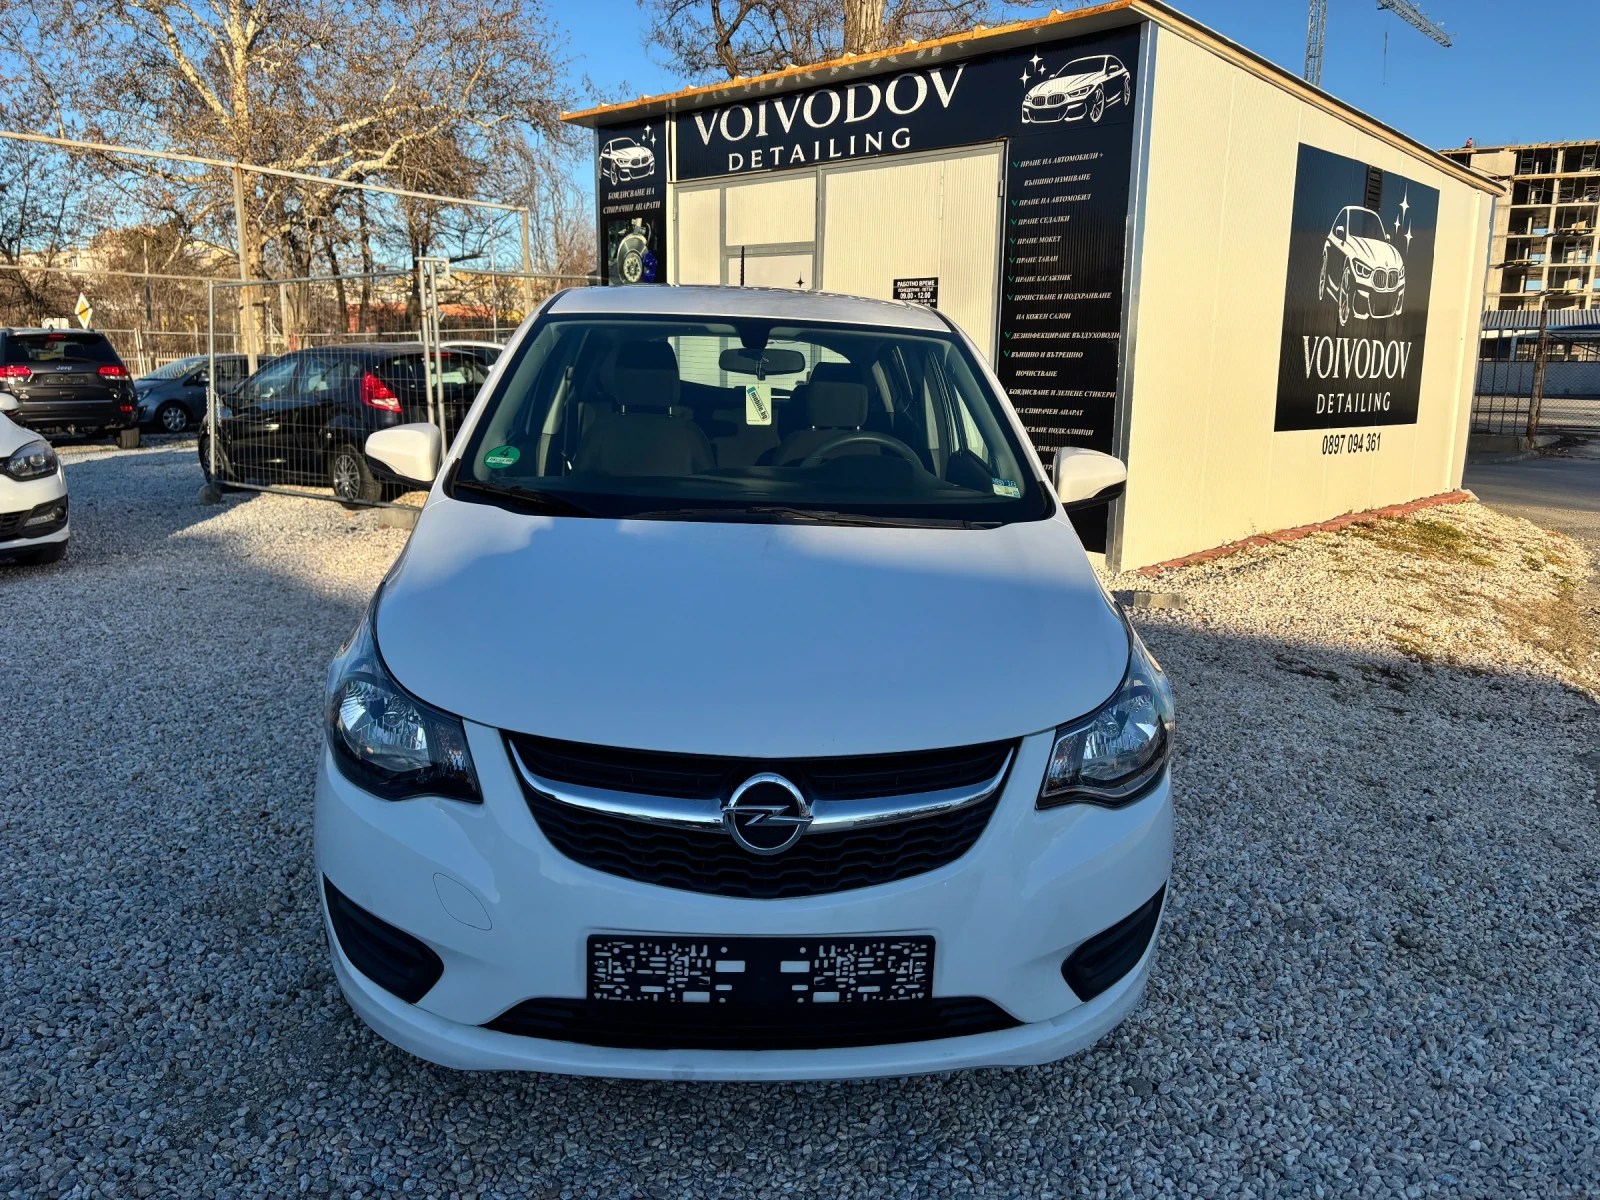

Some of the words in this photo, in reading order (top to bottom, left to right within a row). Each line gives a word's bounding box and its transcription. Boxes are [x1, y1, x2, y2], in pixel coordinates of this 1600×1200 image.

[692, 63, 968, 146] VOIVODOV
[728, 127, 911, 171] DETAILING
[1020, 159, 1041, 168] ПРАНЕ
[1042, 158, 1051, 166] НА
[1052, 152, 1099, 164] АВТОМОБИЛИ
[1024, 177, 1054, 187] ВЪНШНО
[1054, 173, 1091, 184] ИЗМИВАНЕ
[1019, 199, 1040, 207] ПРАНЕ
[1051, 193, 1091, 204] АВТОМОБИЛ
[1018, 218, 1039, 226] ПРАНЕ
[1040, 215, 1070, 225] СЕДАЛКИ
[1017, 237, 1038, 245] ПРАНЕ
[1039, 235, 1062, 243] МОКЕТ
[1016, 256, 1037, 264] ПРАНЕ
[1038, 255, 1058, 263] ТАВАН
[1036, 274, 1072, 282] БАГАЖНИК
[1049, 312, 1071, 320] САЛОН
[1011, 332, 1071, 340] ДЕЗИНФЕКЦИРАНЕ
[1302, 335, 1412, 379] VOIVODOV
[1009, 388, 1050, 396] БОЯДИСВАНЕ
[1056, 389, 1083, 397] ЛЕПЕНЕ
[1084, 391, 1116, 399] СТИКЕРИ
[751, 392, 768, 419] mobile.bg
[1316, 392, 1391, 414] DETAILING
[1025, 407, 1058, 415] СПИРАЧЕН
[1048, 427, 1094, 437] ПОДКАЛНИЦИ
[1322, 434, 1346, 455] 0897
[1347, 433, 1364, 454] 094
[1365, 432, 1381, 453] 361
[500, 447, 512, 457] 4
